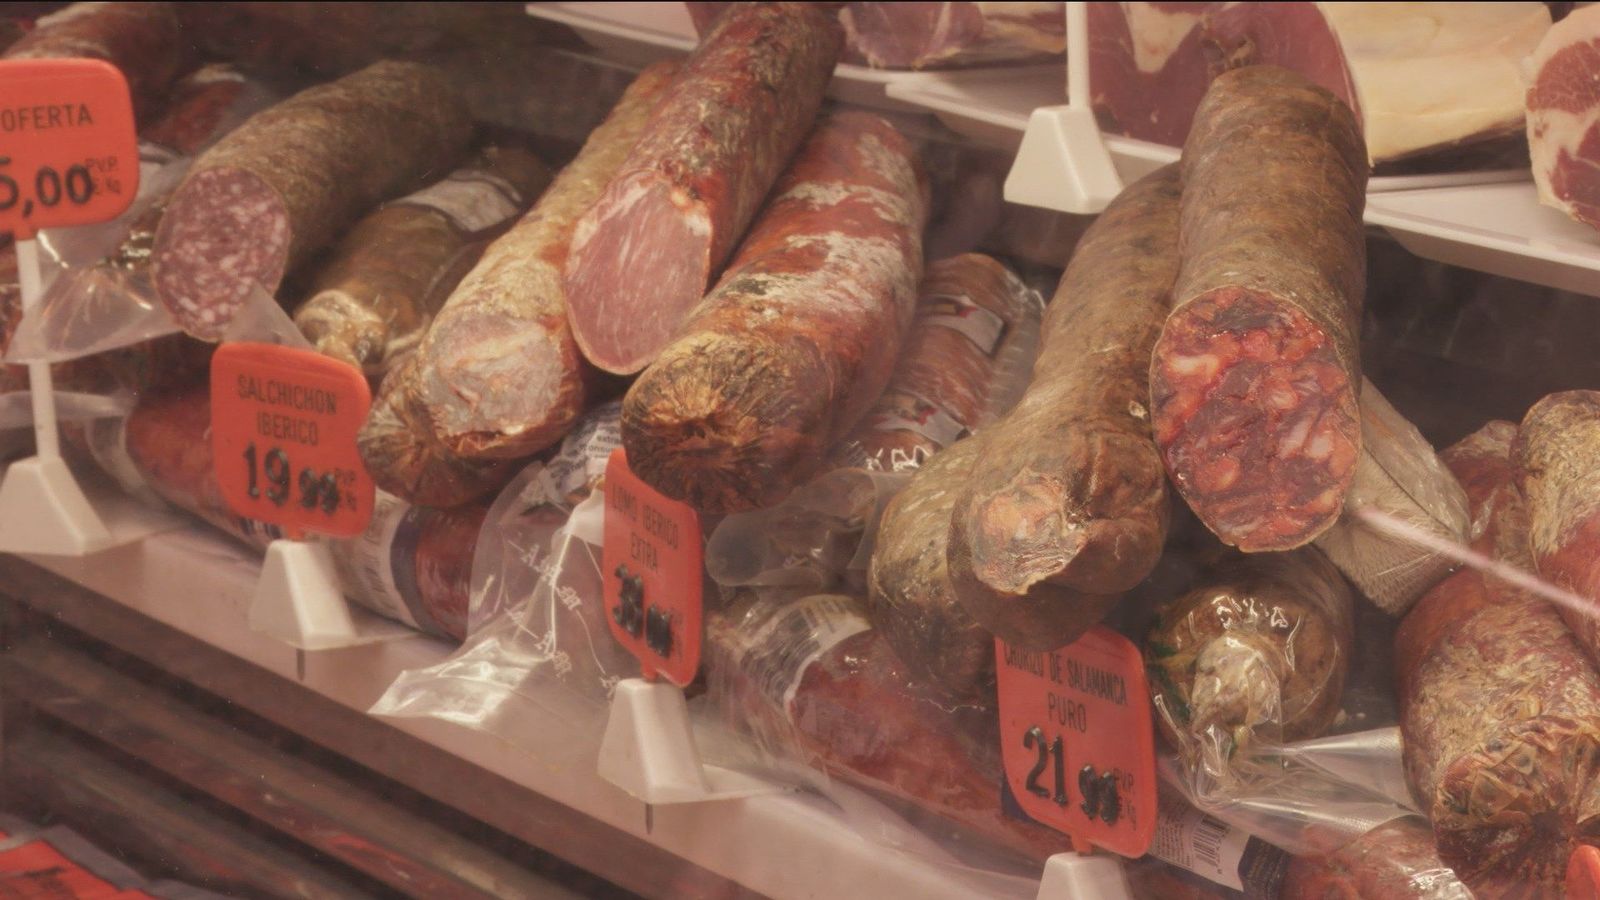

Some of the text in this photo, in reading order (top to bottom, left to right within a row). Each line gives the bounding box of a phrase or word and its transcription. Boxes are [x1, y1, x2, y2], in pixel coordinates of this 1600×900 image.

[1, 103, 94, 132] OFERTA
[237, 374, 337, 416] SALCHICHON
[257, 411, 319, 446] IBERICO
[643, 503, 679, 551] IBERICO
[631, 530, 659, 574] EXTRA
[1049, 652, 1064, 685] DE
[1066, 657, 1128, 706] SALAMANCA
[1047, 691, 1087, 733] PURO
